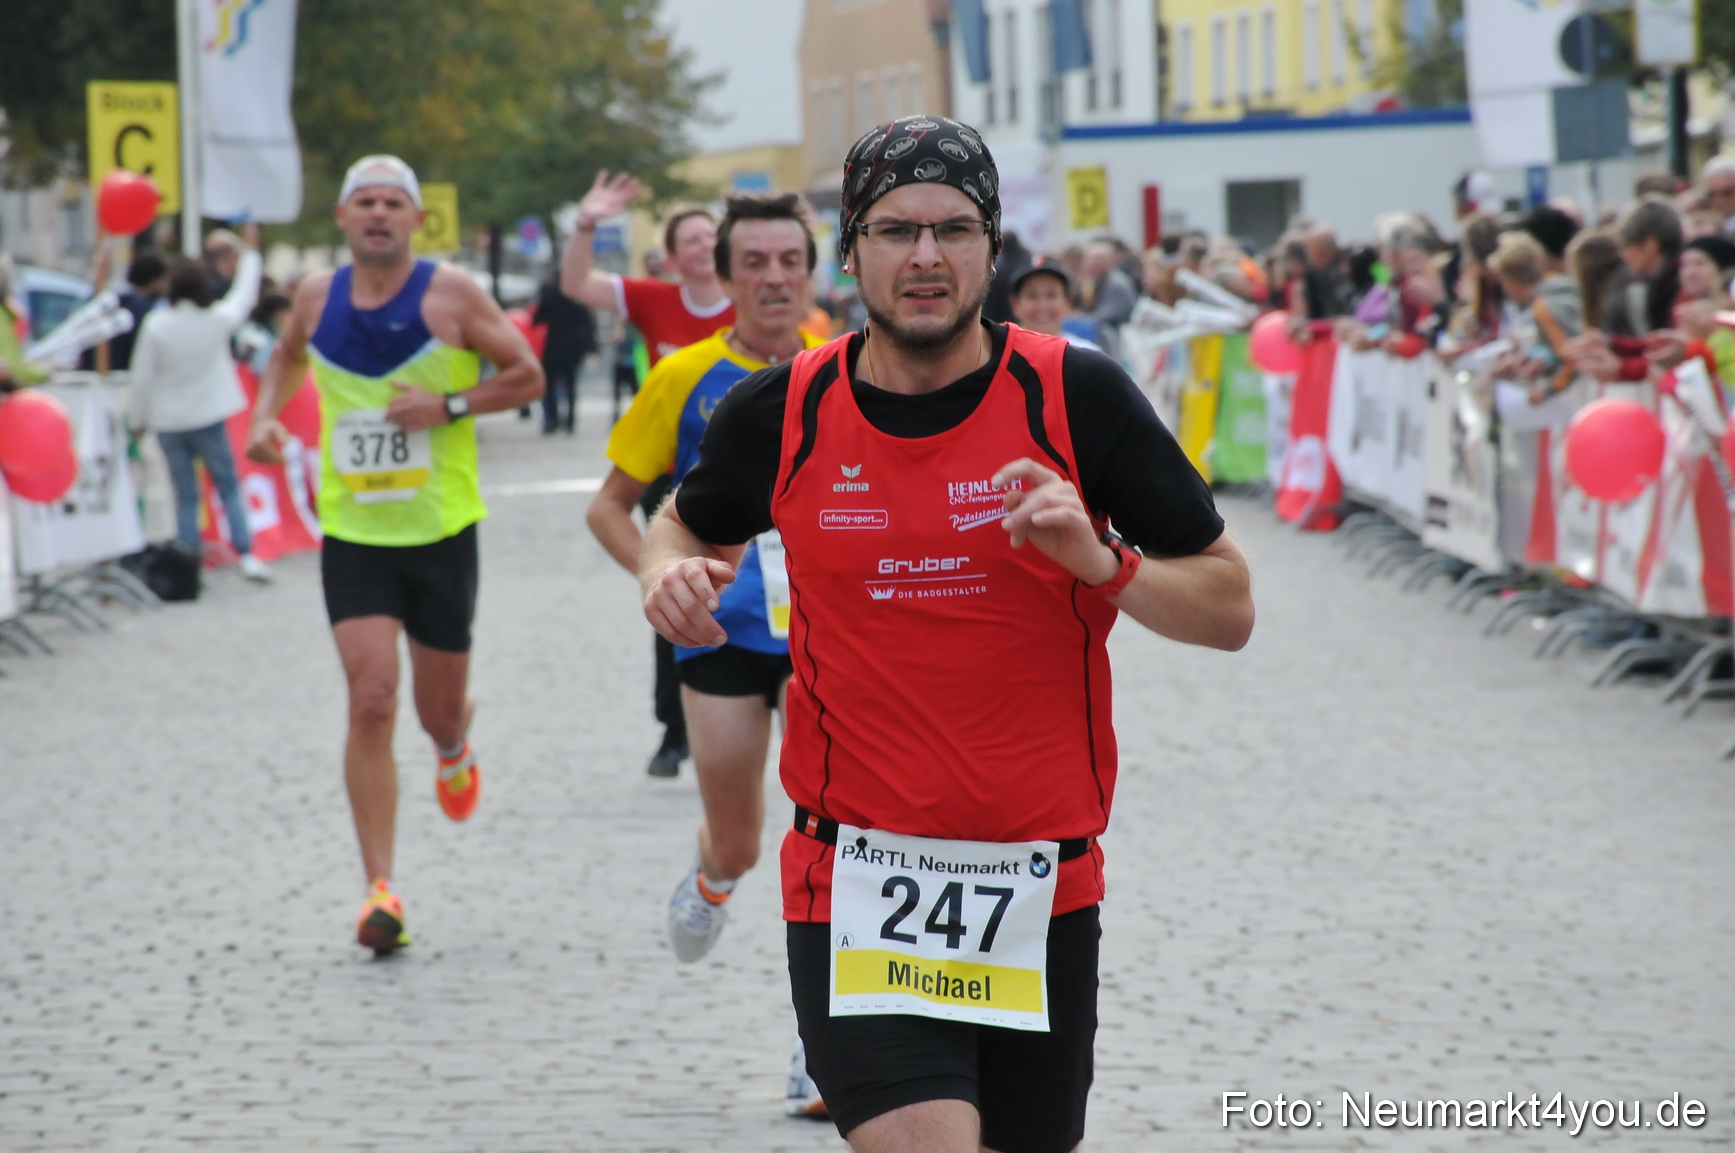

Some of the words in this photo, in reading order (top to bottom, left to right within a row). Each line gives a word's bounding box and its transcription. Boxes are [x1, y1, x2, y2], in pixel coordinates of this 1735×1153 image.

[114, 123, 153, 174] C
[351, 431, 410, 466] 378
[833, 481, 869, 492] erima
[948, 478, 1022, 497] HEINLH
[878, 557, 970, 574] Gruber
[898, 590, 913, 599] DIE
[917, 586, 987, 598] BADGESTALTER
[842, 844, 913, 869] PARTL
[918, 855, 1020, 875] Neumarkt
[879, 875, 1015, 953] 247
[840, 935, 850, 947] A
[887, 960, 991, 1001] Michael
